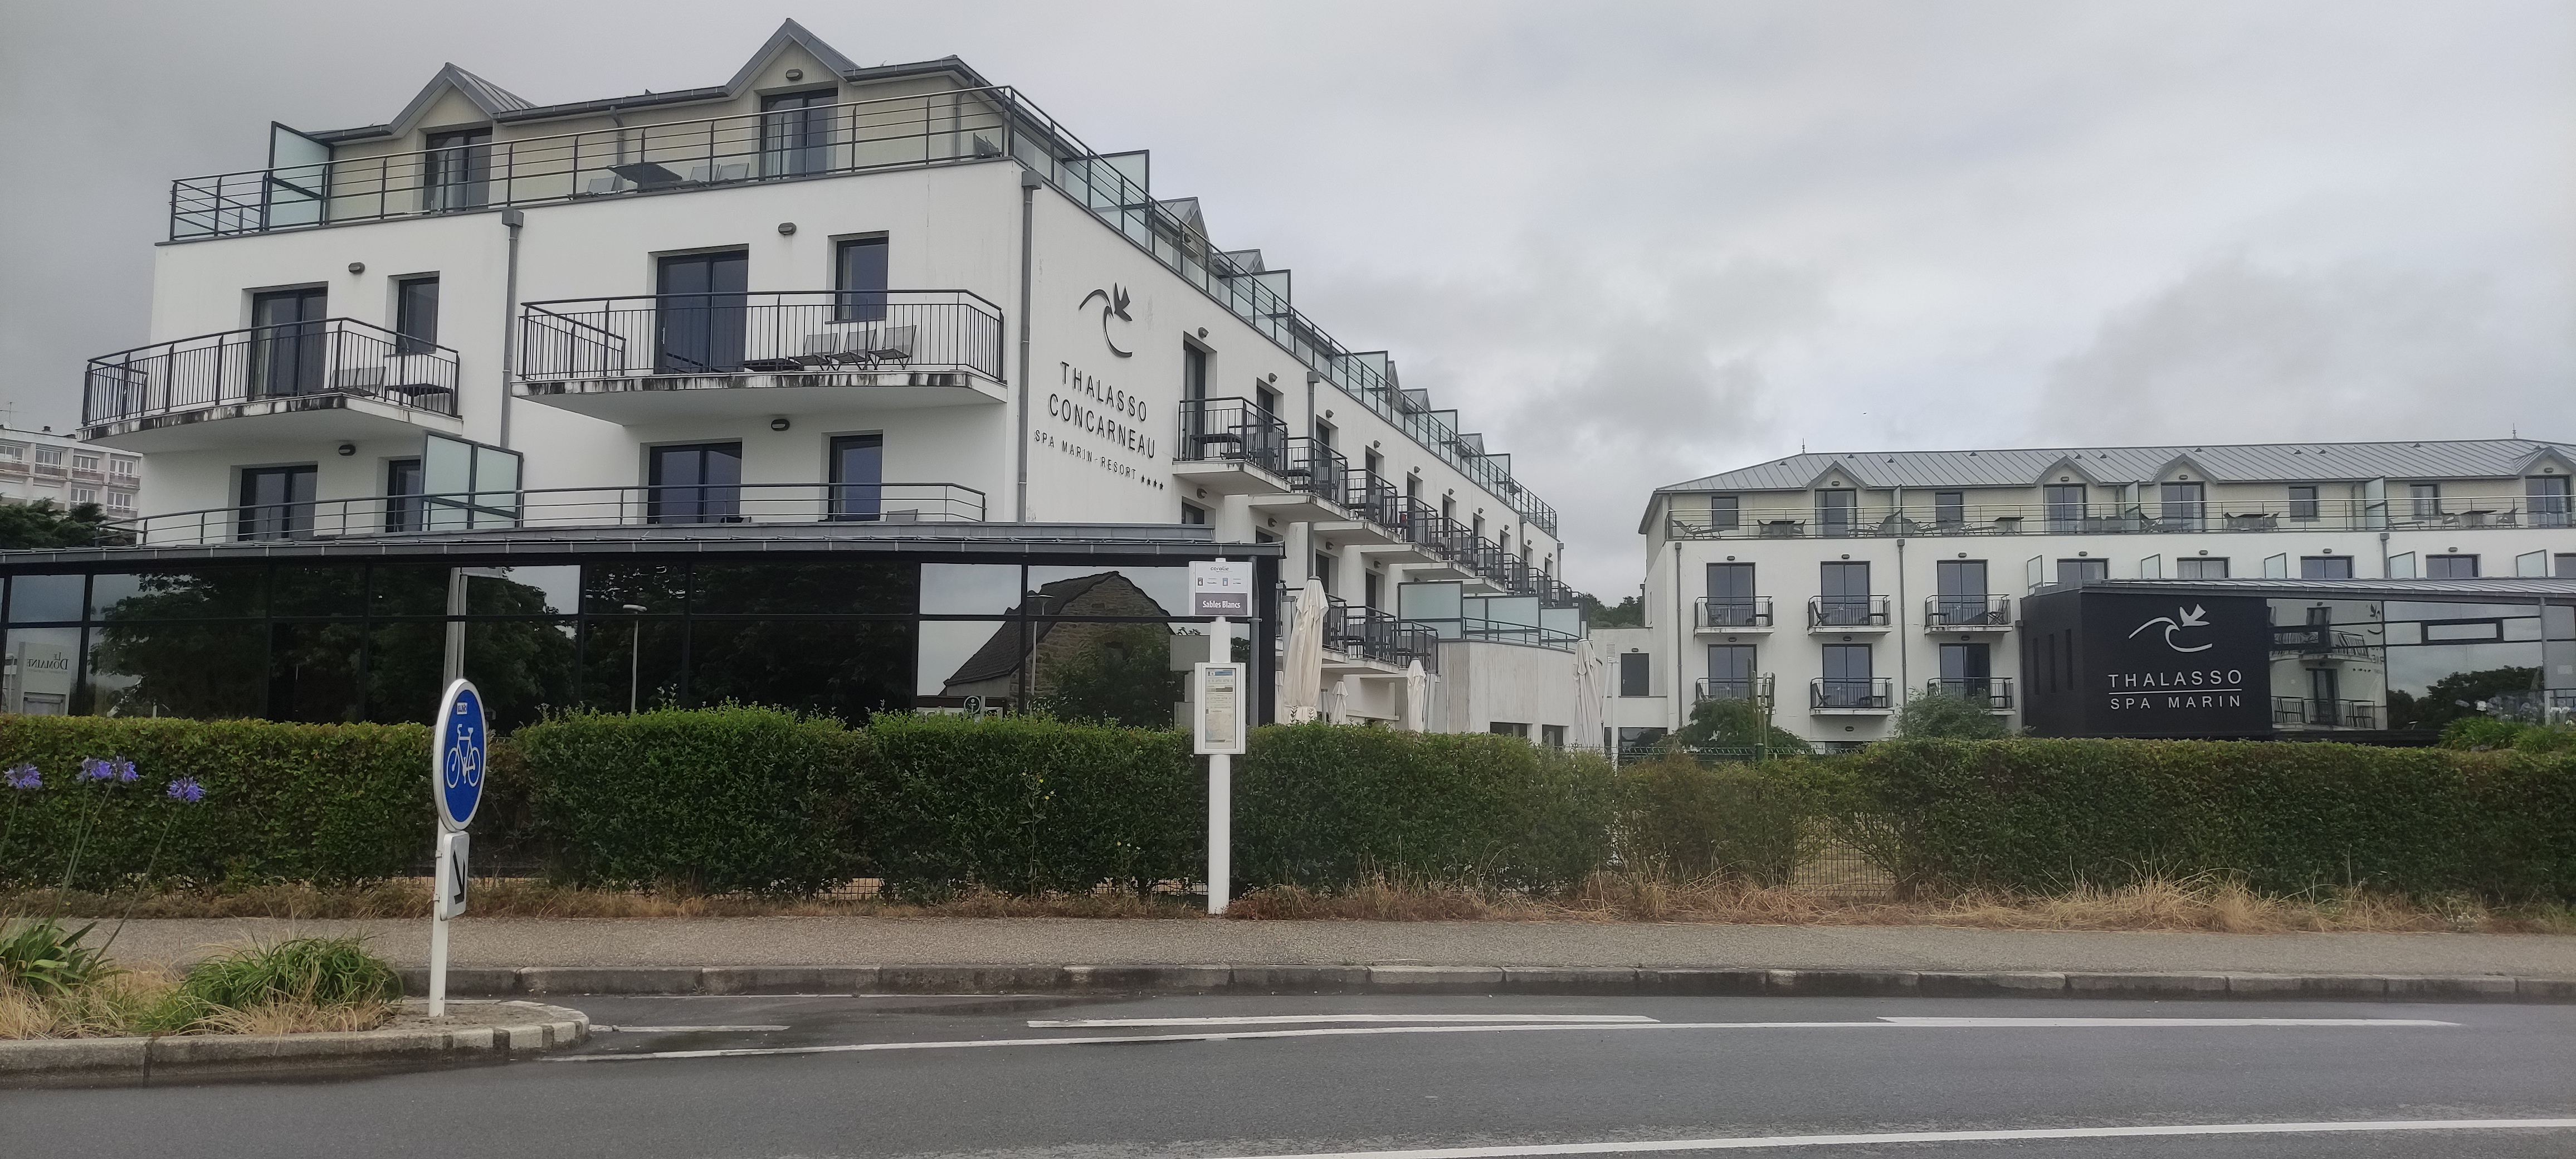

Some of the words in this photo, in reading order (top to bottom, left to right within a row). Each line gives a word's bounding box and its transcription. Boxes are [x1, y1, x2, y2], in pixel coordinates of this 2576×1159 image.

[1061, 361, 1146, 422] THALASSO
[1049, 393, 1155, 459] CONCARNEAU
[1035, 430, 1055, 447] SPA
[1203, 600, 1221, 608] Sables
[2108, 669, 2242, 688] THALASSO
[2110, 698, 2150, 710] SPA
[2168, 695, 2240, 708] MARIN
